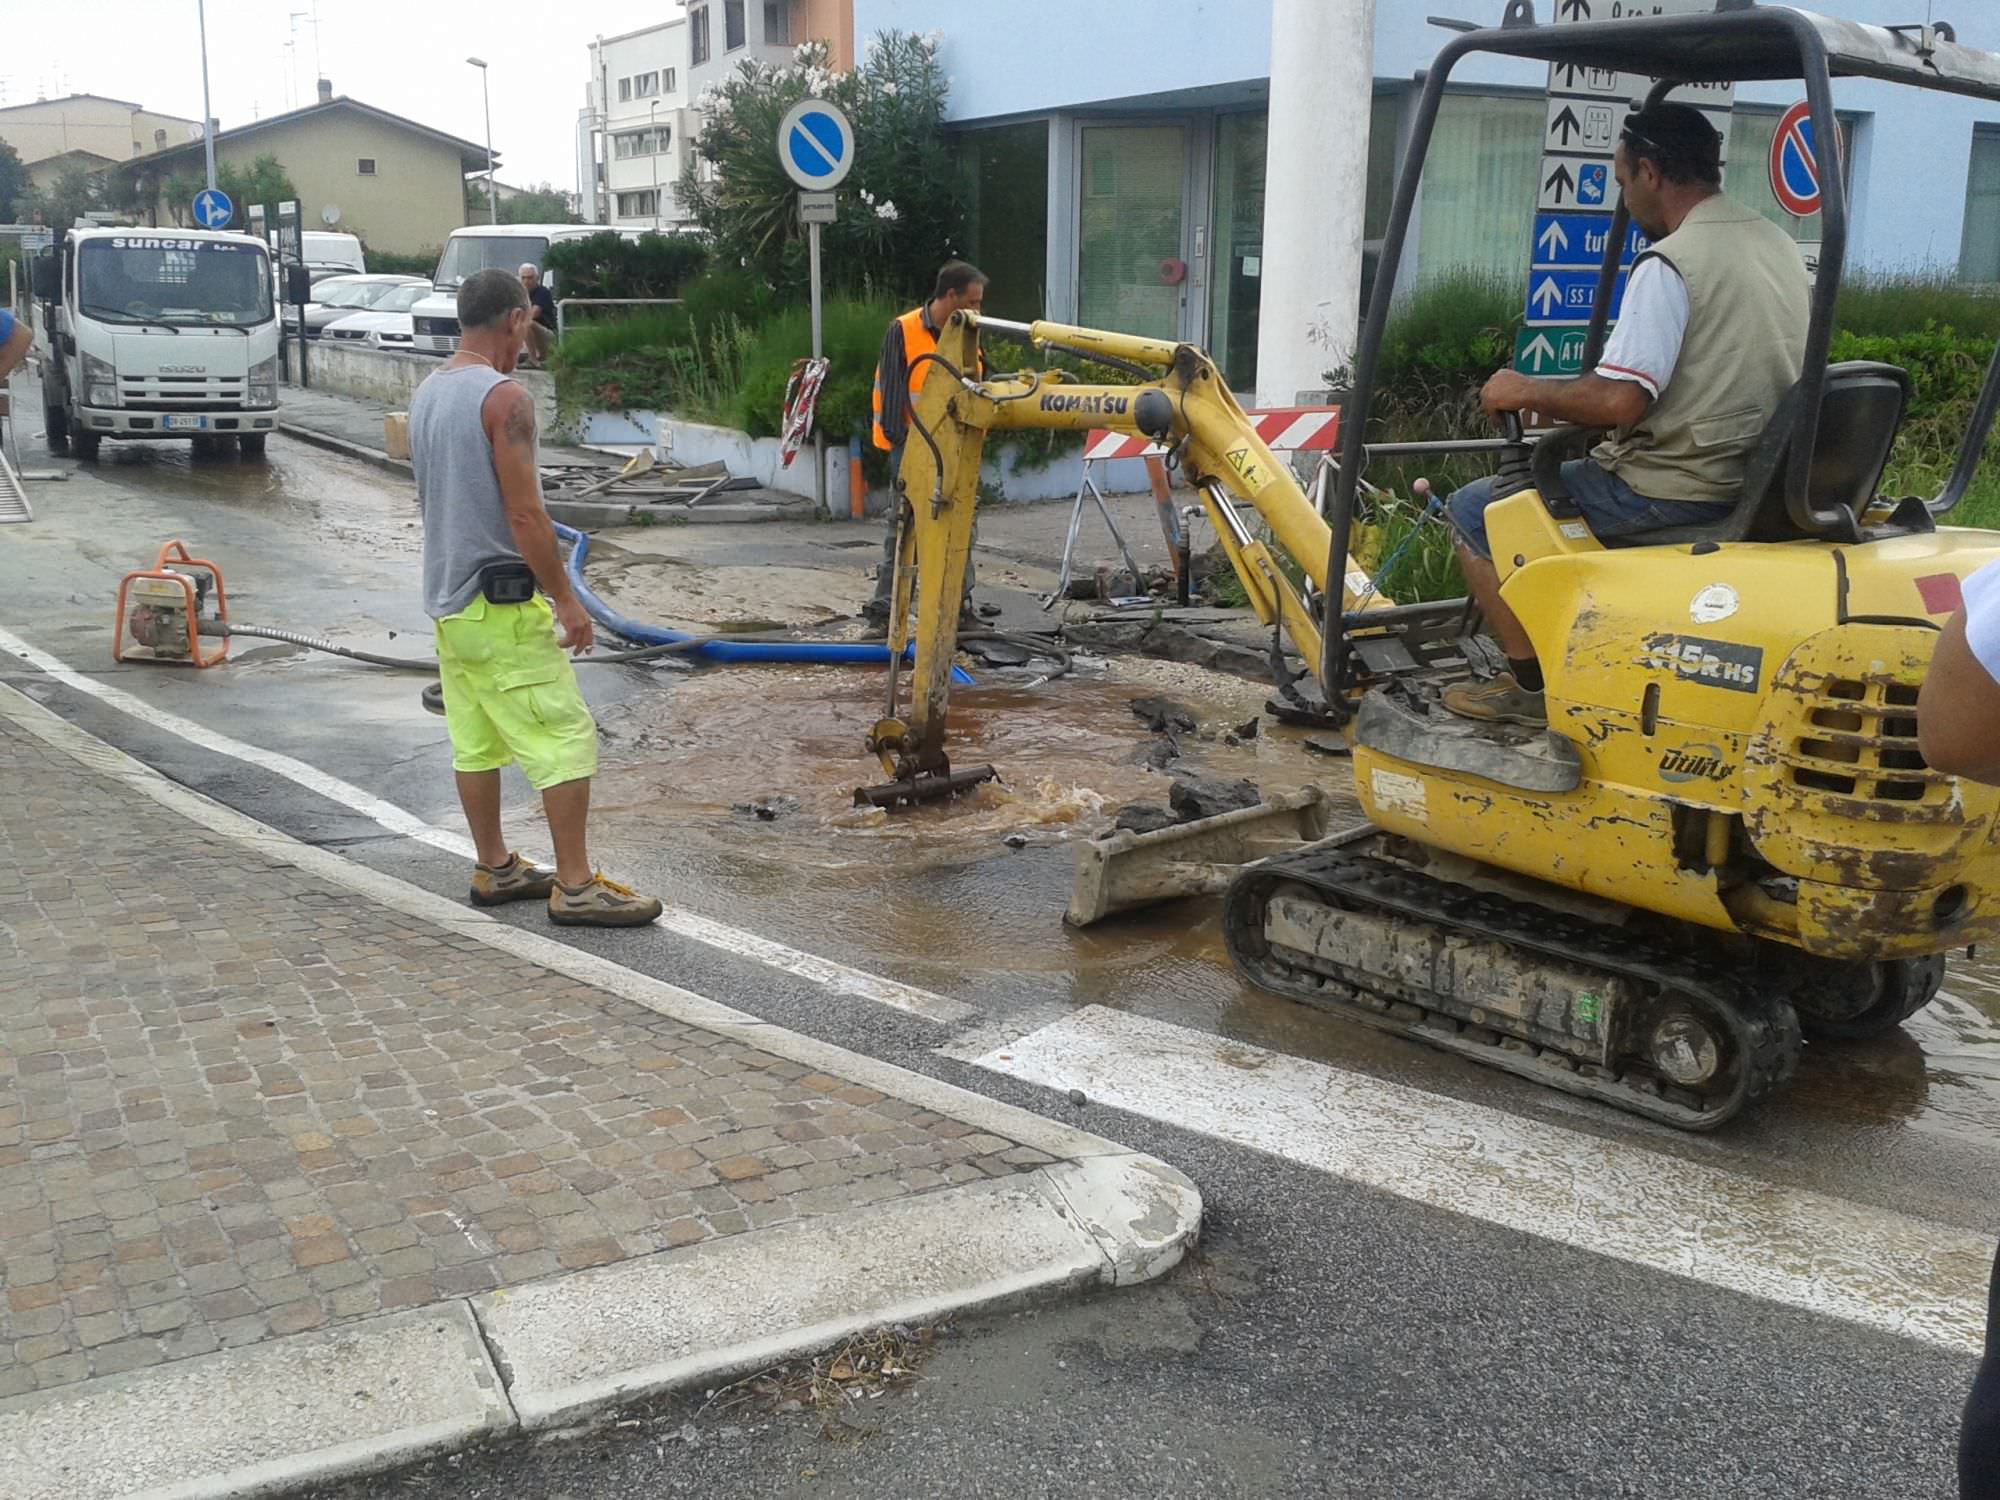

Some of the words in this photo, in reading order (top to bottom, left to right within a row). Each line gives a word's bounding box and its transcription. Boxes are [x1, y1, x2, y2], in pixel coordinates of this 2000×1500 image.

[111, 238, 204, 250] suncar
[1570, 288, 1585, 304] SS
[1561, 341, 1571, 361] A
[1040, 393, 1128, 414] KOMATSU
